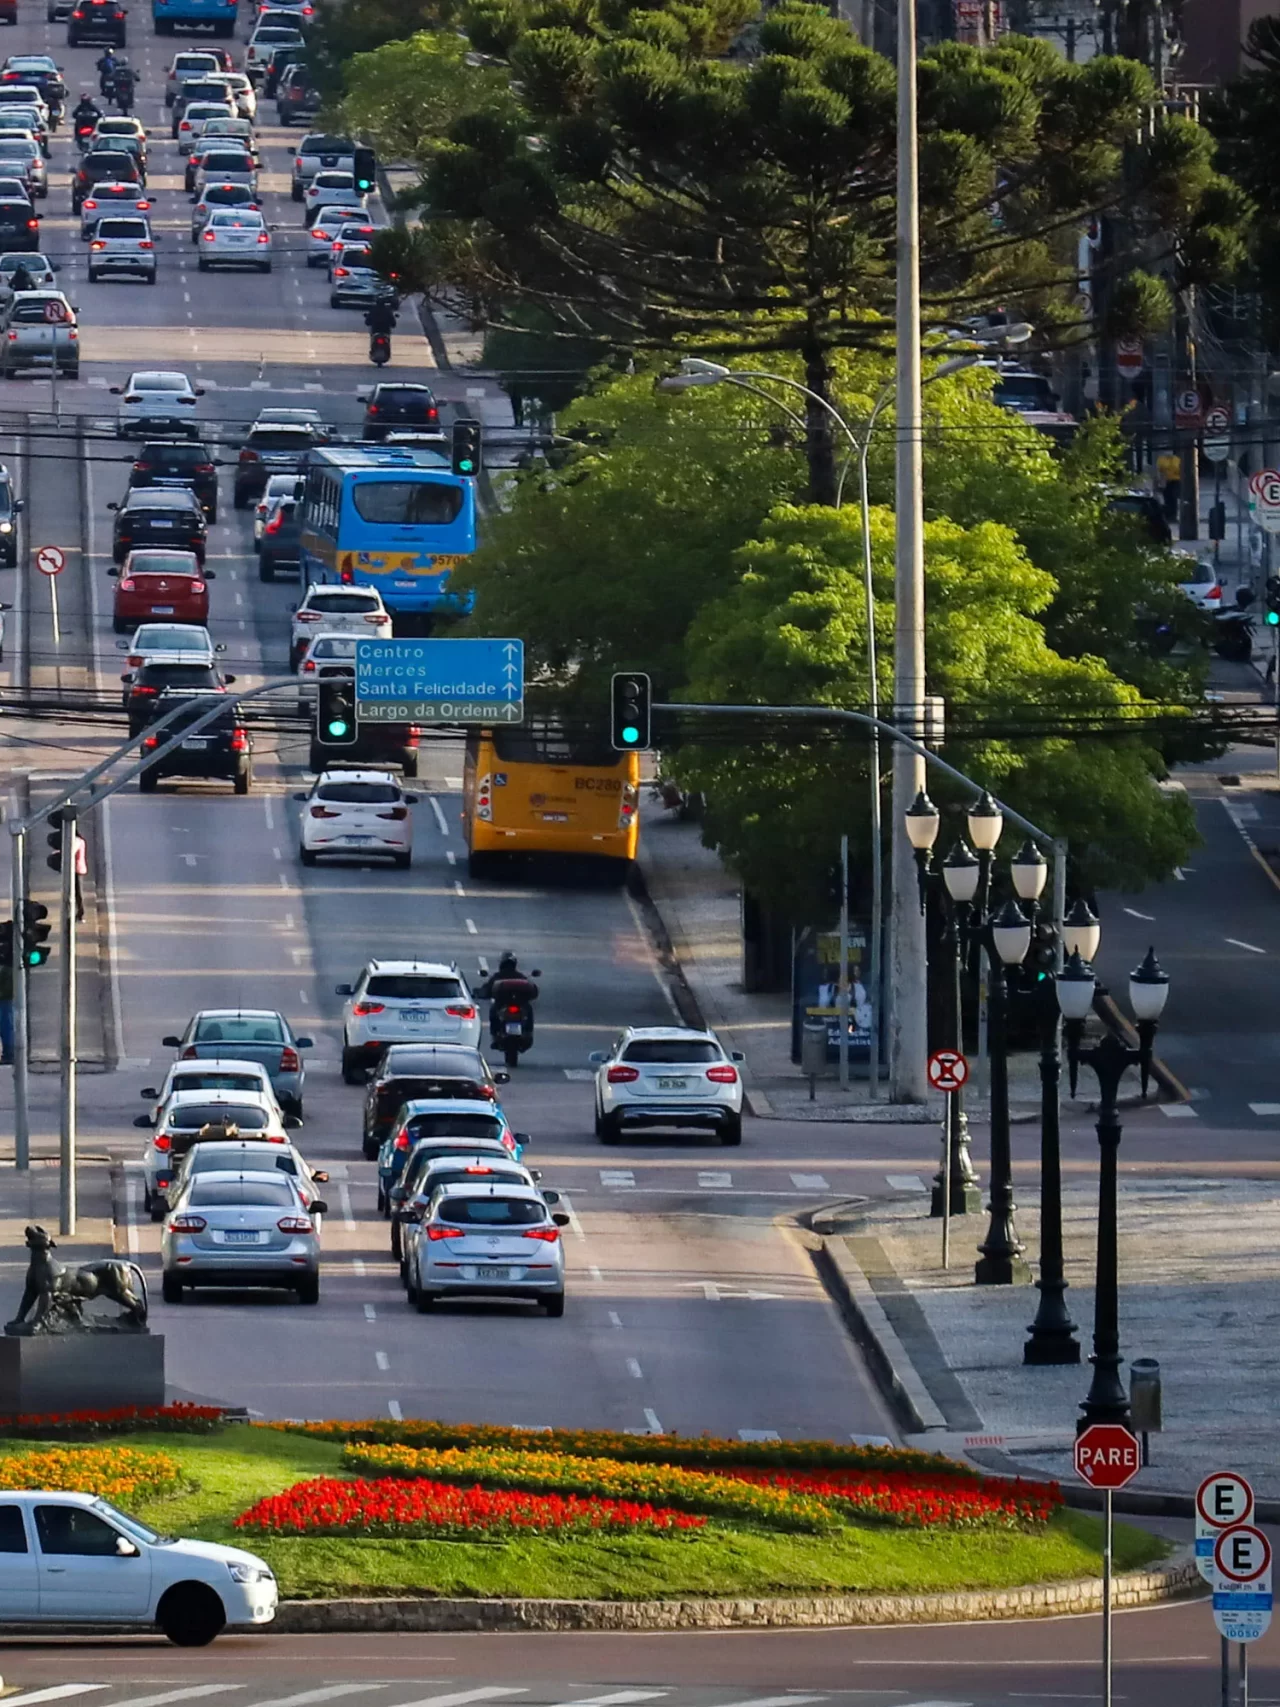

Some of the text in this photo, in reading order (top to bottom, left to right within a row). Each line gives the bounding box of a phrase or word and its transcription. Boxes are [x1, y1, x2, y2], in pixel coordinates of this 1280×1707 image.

[359, 644, 424, 658] Centro
[359, 681, 496, 695] Santa Felicidade
[358, 703, 498, 719] Largo da Ordem
[1079, 1447, 1135, 1466] PARE
[1214, 1484, 1235, 1516] E
[1232, 1537, 1252, 1569] E
